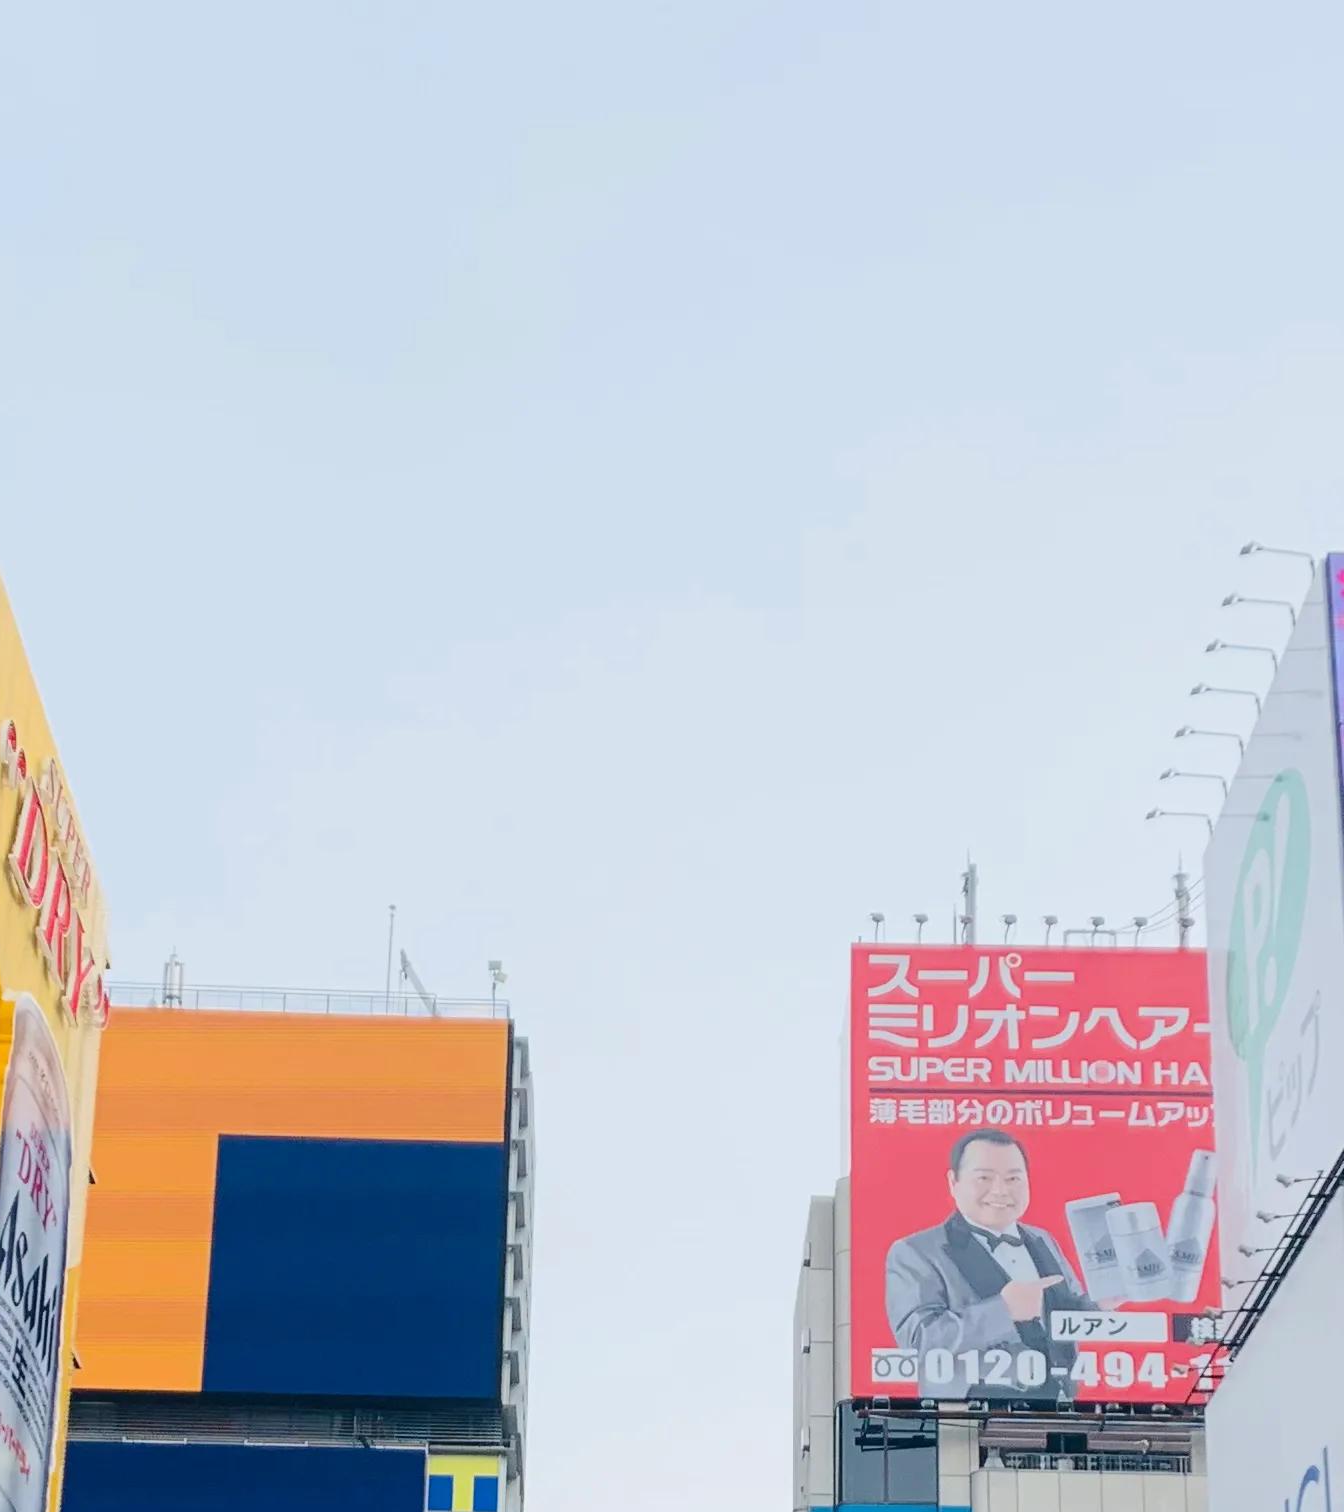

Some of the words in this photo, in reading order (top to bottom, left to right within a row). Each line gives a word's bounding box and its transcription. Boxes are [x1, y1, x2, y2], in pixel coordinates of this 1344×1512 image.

[867, 952, 1076, 999] スーパー
[867, 1055, 992, 1084] SUPER
[1004, 1059, 1142, 1086] MILLION
[1154, 1063, 1213, 1087] HA
[868, 1098, 1216, 1129] 薄毛部分のボリュームアッ
[1059, 1316, 1128, 1337] ルアン
